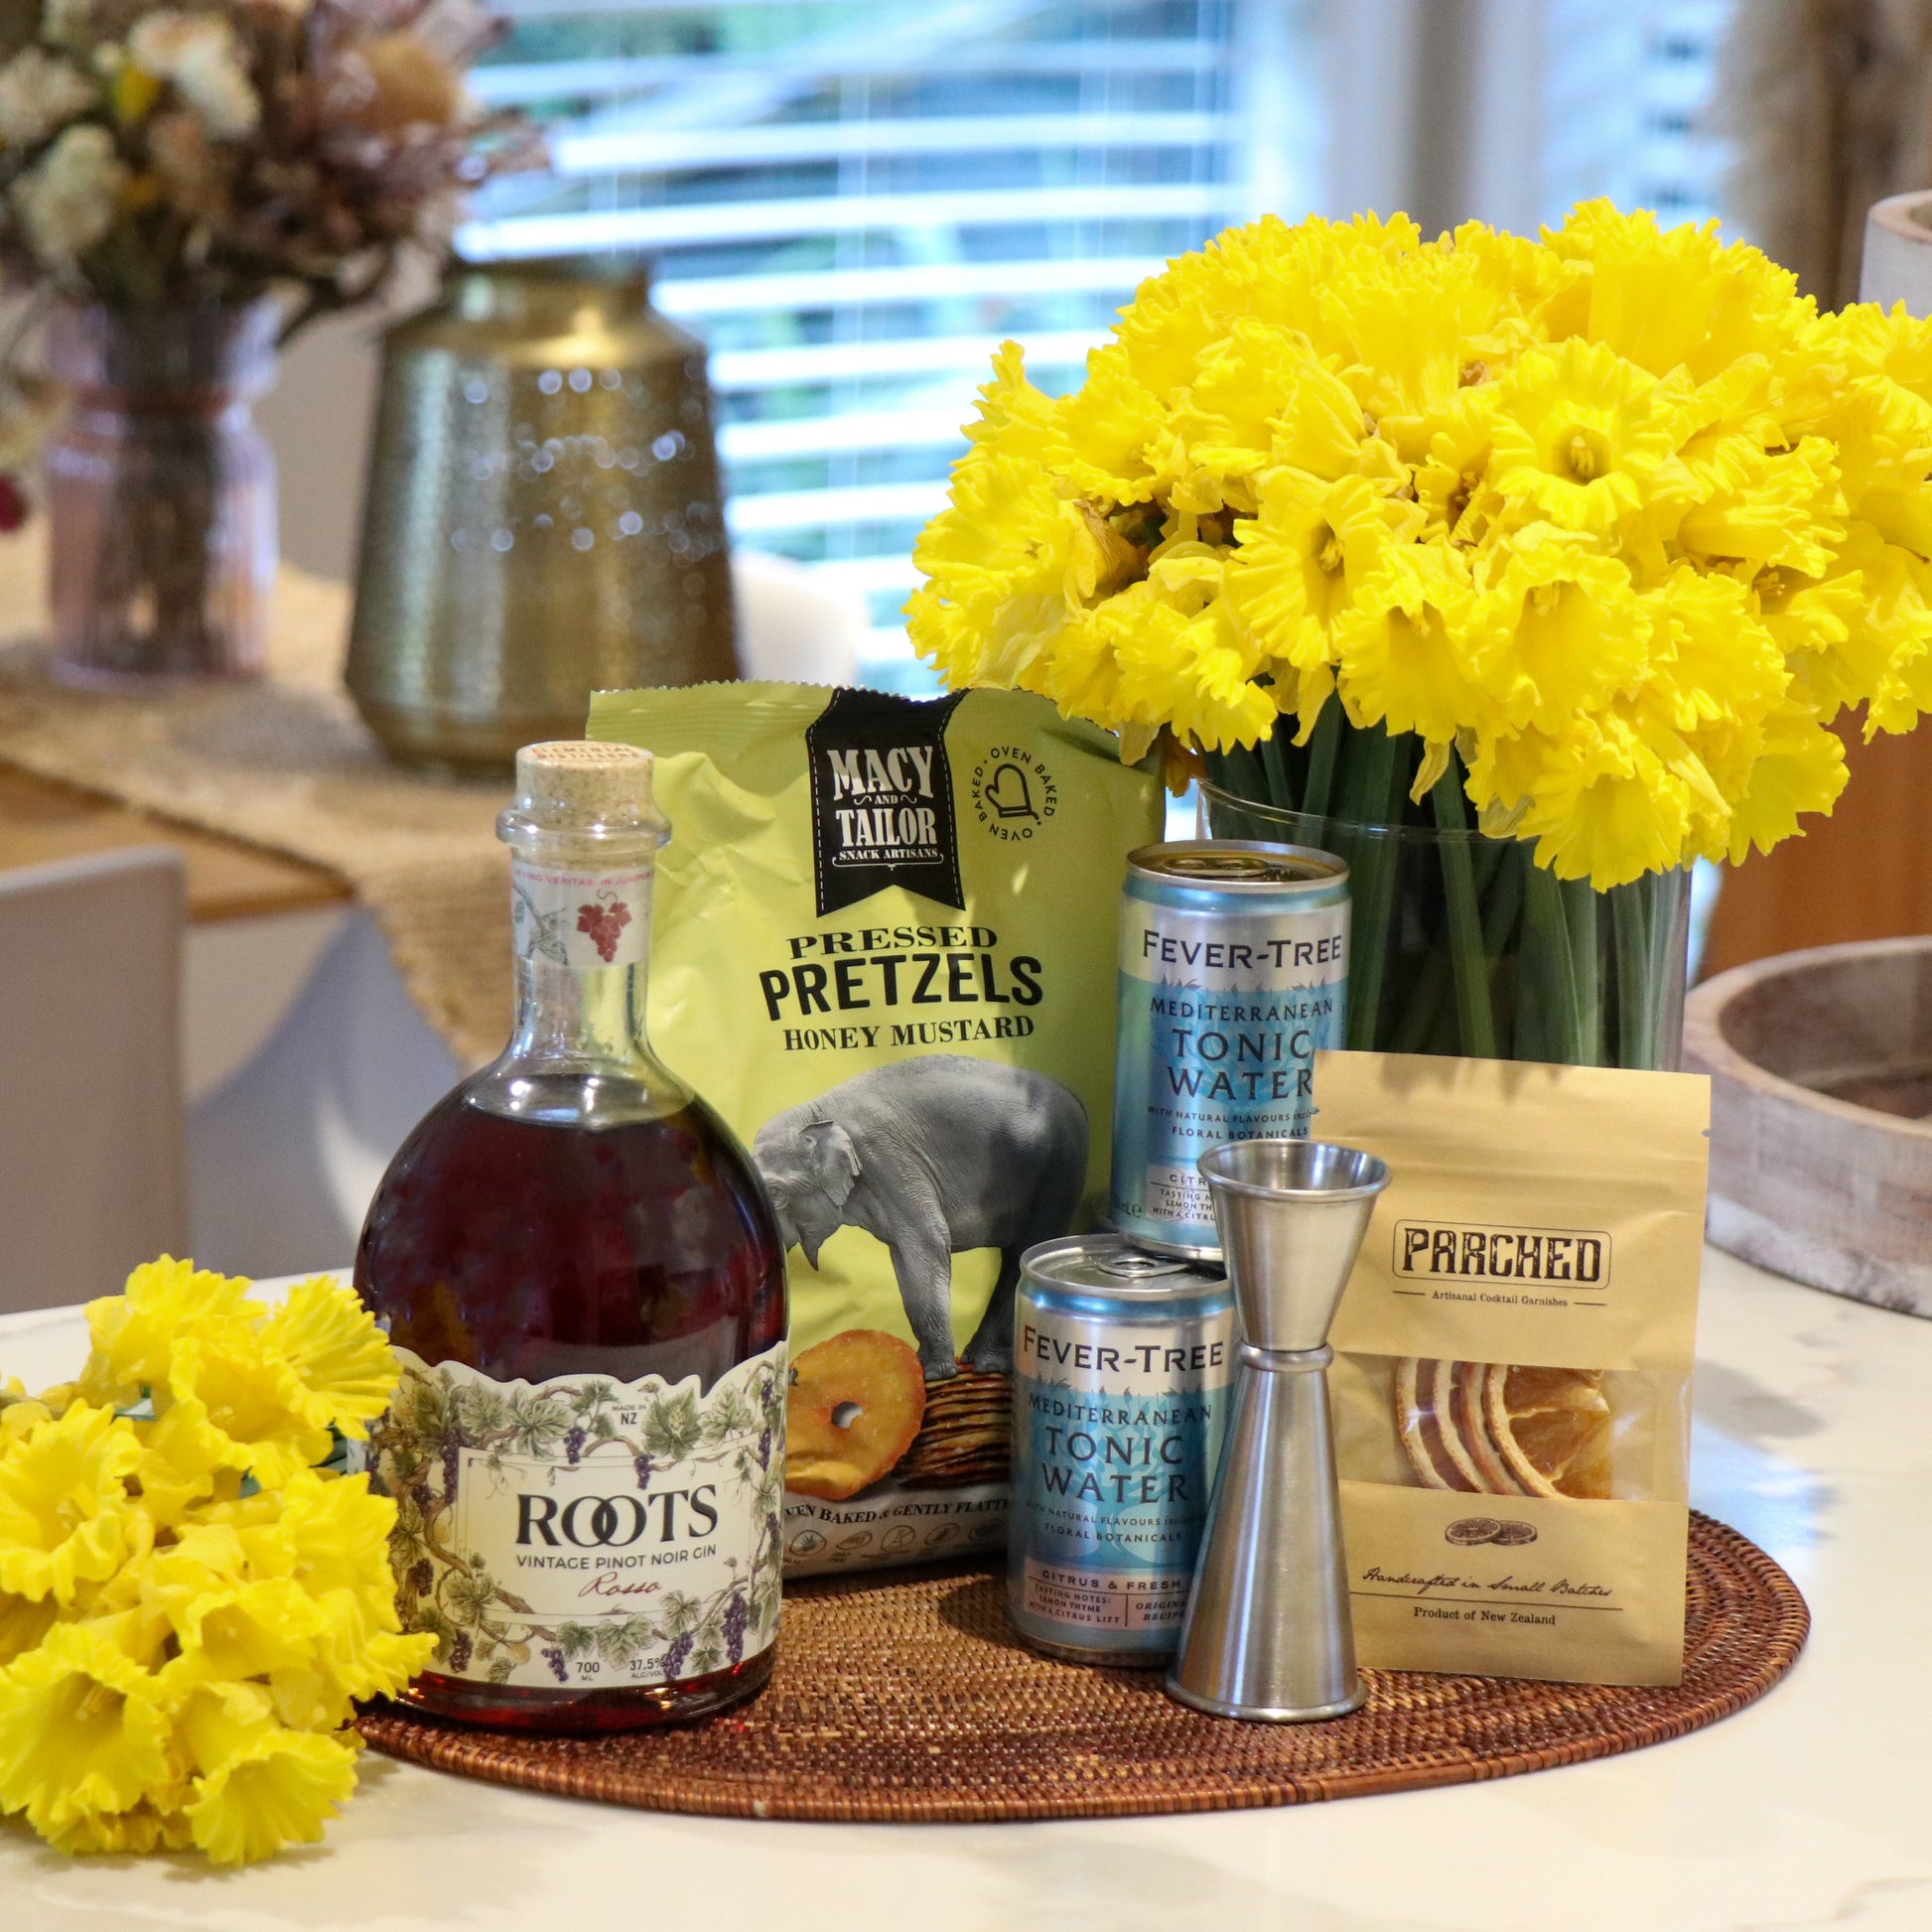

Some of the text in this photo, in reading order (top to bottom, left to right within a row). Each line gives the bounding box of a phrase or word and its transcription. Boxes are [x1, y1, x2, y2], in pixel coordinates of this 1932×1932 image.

[827, 746, 934, 801] MACY
[991, 747, 1056, 816] OVEN BAKED
[875, 795, 898, 805] AND
[972, 766, 1034, 841] OVEN BAKED
[835, 807, 937, 847] TAILOR
[839, 848, 938, 861] SNACK ARTISANS
[786, 925, 999, 960] PRESSED
[1143, 929, 1342, 969] FEVER-TREE
[759, 953, 1043, 1022] PRETZELS
[1151, 998, 1333, 1023] MEDITERRANEAN
[782, 1016, 1035, 1050] HONEY MUSTARD
[1172, 1029, 1311, 1061] TONIC
[1168, 1066, 1312, 1100] WATER
[1148, 1106, 1173, 1117] WITH
[1176, 1110, 1228, 1123] NATURAL
[1233, 1111, 1290, 1123] FLAVOURS
[1172, 1126, 1310, 1140] FLORAL BOTANICALS
[1170, 1173, 1207, 1186] CITR
[1160, 1188, 1200, 1200] TASTING
[1166, 1199, 1197, 1209] LEMON
[1153, 1207, 1173, 1216] WITH
[1402, 1227, 1602, 1283] PARCHED
[1432, 1290, 1569, 1308] Artisanal Cocktail Garnishes
[1024, 1324, 1224, 1373] FEVER-TREE
[621, 1412, 637, 1425] NZ
[1029, 1392, 1212, 1426] MEDITERRANEAN
[1044, 1426, 1182, 1465] TONIC
[1042, 1462, 1191, 1504] WATER
[515, 1484, 719, 1548] ROOTS
[819, 1507, 877, 1524] BAKED
[879, 1509, 890, 1520] &
[893, 1502, 954, 1517] GENTLY
[1048, 1509, 1096, 1524] NATURAL
[1101, 1516, 1161, 1526] FLAVOURS
[1044, 1523, 1182, 1543] FLORAL BOTANICALS
[516, 1544, 717, 1570] VINTAGE PINOT NOIR GIN
[578, 1572, 662, 1597] Rosso
[1042, 1570, 1181, 1589] CITRUS & FRESH
[1362, 1567, 1613, 1596] Handcrafted in Small Batches
[1035, 1584, 1112, 1604] TASTING NOTES:
[1039, 1595, 1066, 1608] LEMON
[1069, 1601, 1101, 1612] THYME
[1029, 1601, 1046, 1614] WITH
[1055, 1608, 1092, 1621] CITRUS
[1096, 1615, 1121, 1624] LIFT
[1413, 1606, 1556, 1625] Product of New Zealand
[577, 1661, 601, 1673] 700
[629, 1657, 665, 1671] 37.5%
